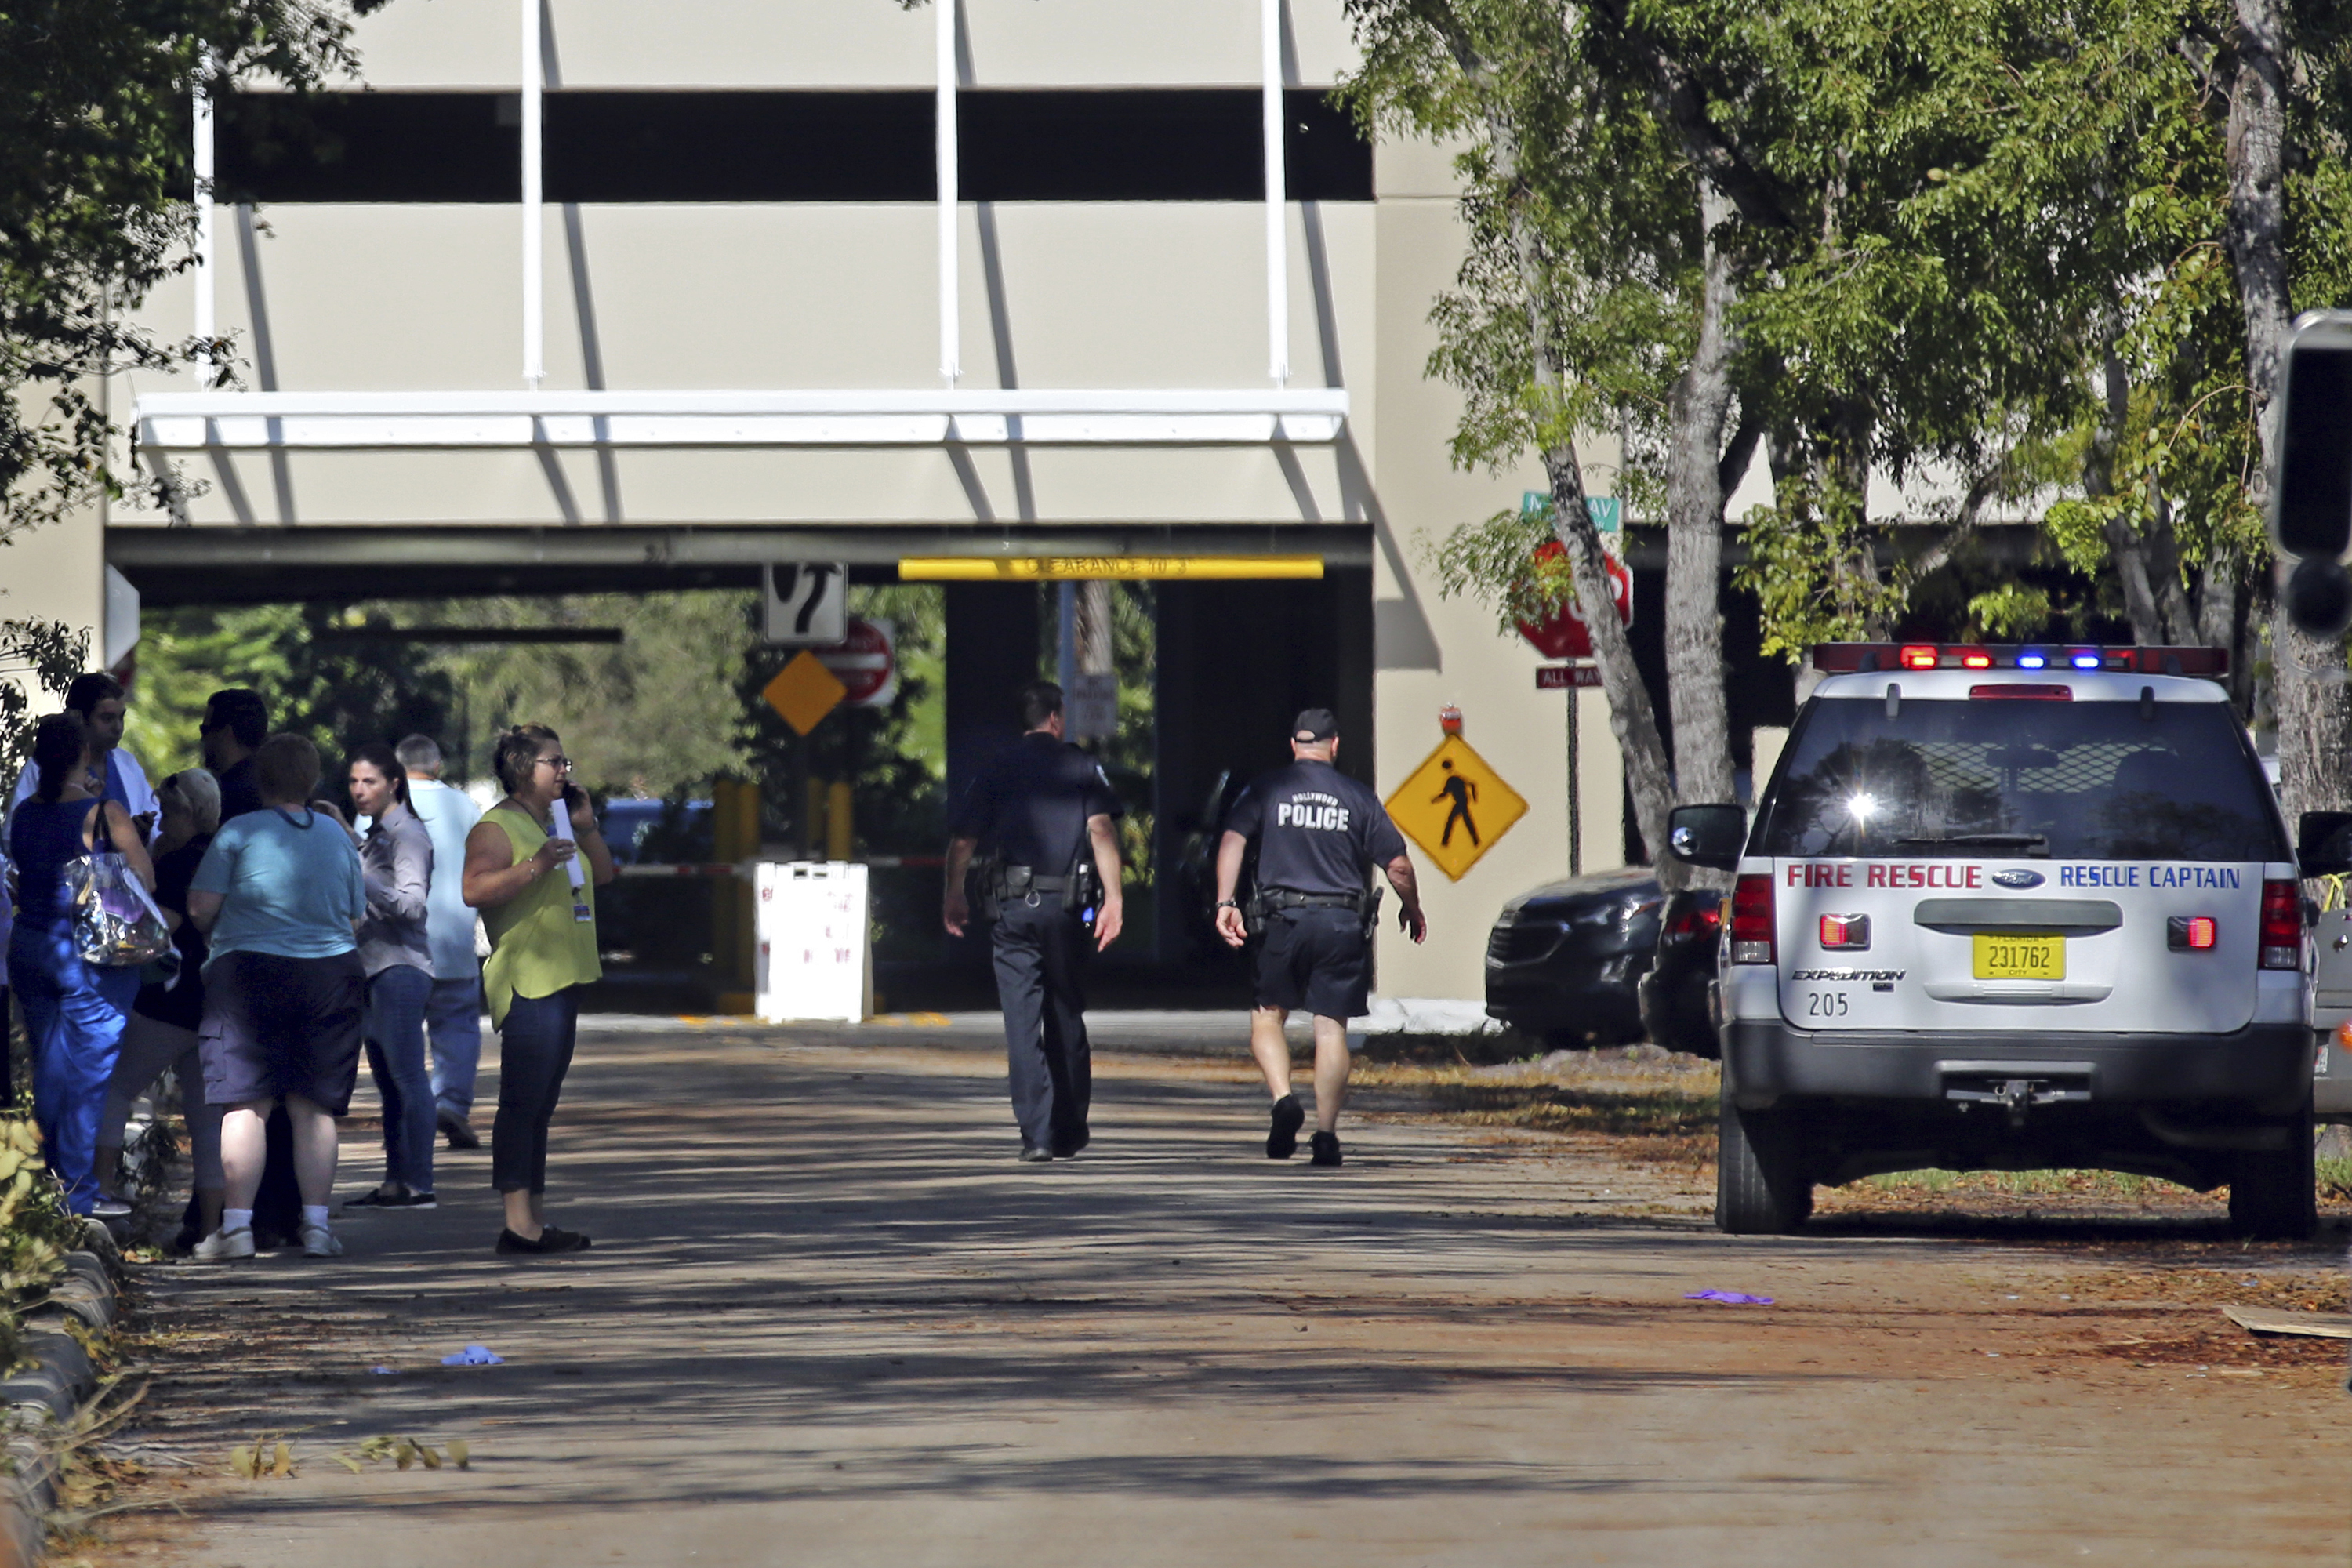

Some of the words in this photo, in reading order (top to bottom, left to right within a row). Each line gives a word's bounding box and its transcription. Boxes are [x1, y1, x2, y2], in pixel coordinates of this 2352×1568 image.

[1590, 499, 1613, 518] AV
[1025, 557, 1142, 575] CLEARANCE
[1543, 670, 1566, 686] ALL
[1291, 792, 1339, 807] HOLLYWOOD
[1277, 802, 1349, 831] POLICE
[1788, 865, 1853, 887] FIRE
[1867, 865, 1982, 889] RESCUE
[2060, 866, 2140, 887] RESCUE
[2150, 866, 2241, 889] CAPTAIN
[1989, 946, 2050, 968] 231762
[1808, 992, 1849, 1017] 205
